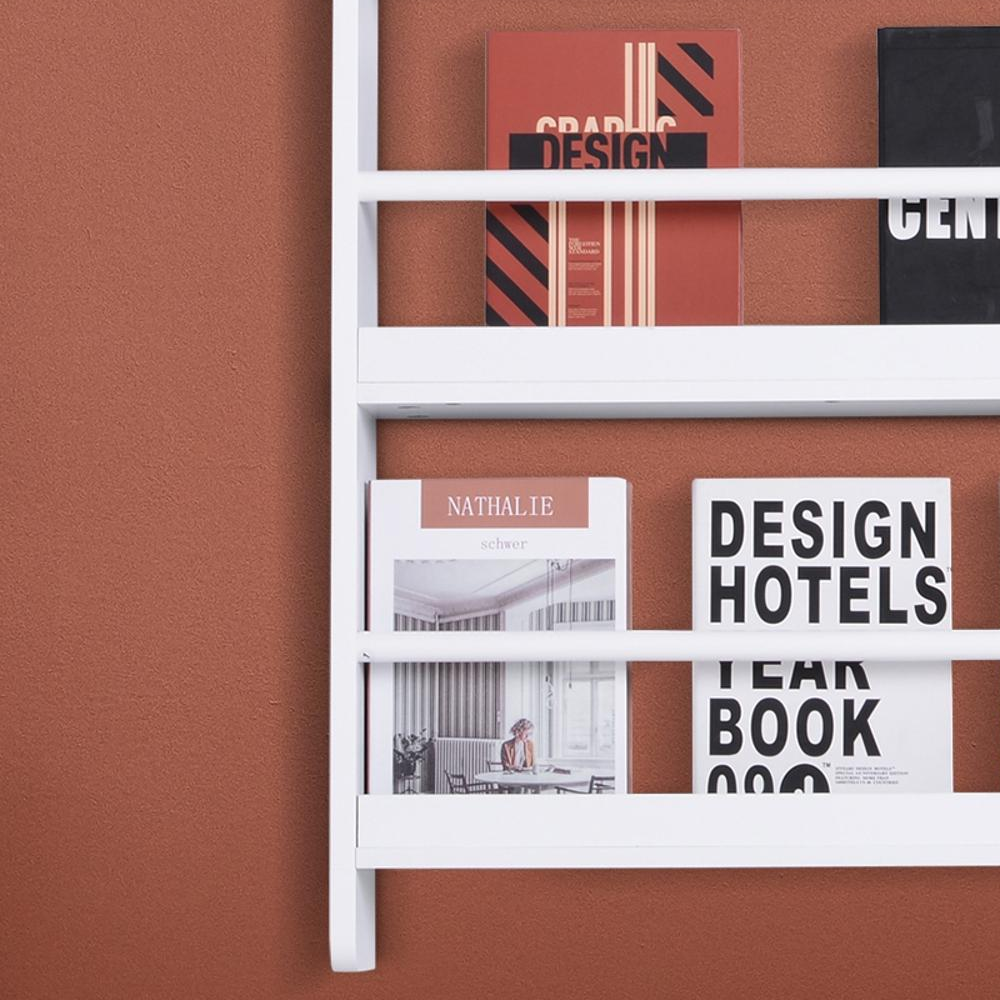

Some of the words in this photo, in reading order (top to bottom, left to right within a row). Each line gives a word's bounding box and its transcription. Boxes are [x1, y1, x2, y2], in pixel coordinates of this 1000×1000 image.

[542, 133, 669, 170] DESIGN
[447, 496, 554, 517] NATHALIE
[710, 500, 936, 559] DESIGN
[480, 538, 529, 550] schwer
[710, 565, 947, 625] HOTELS
[709, 697, 882, 757] BOOK
